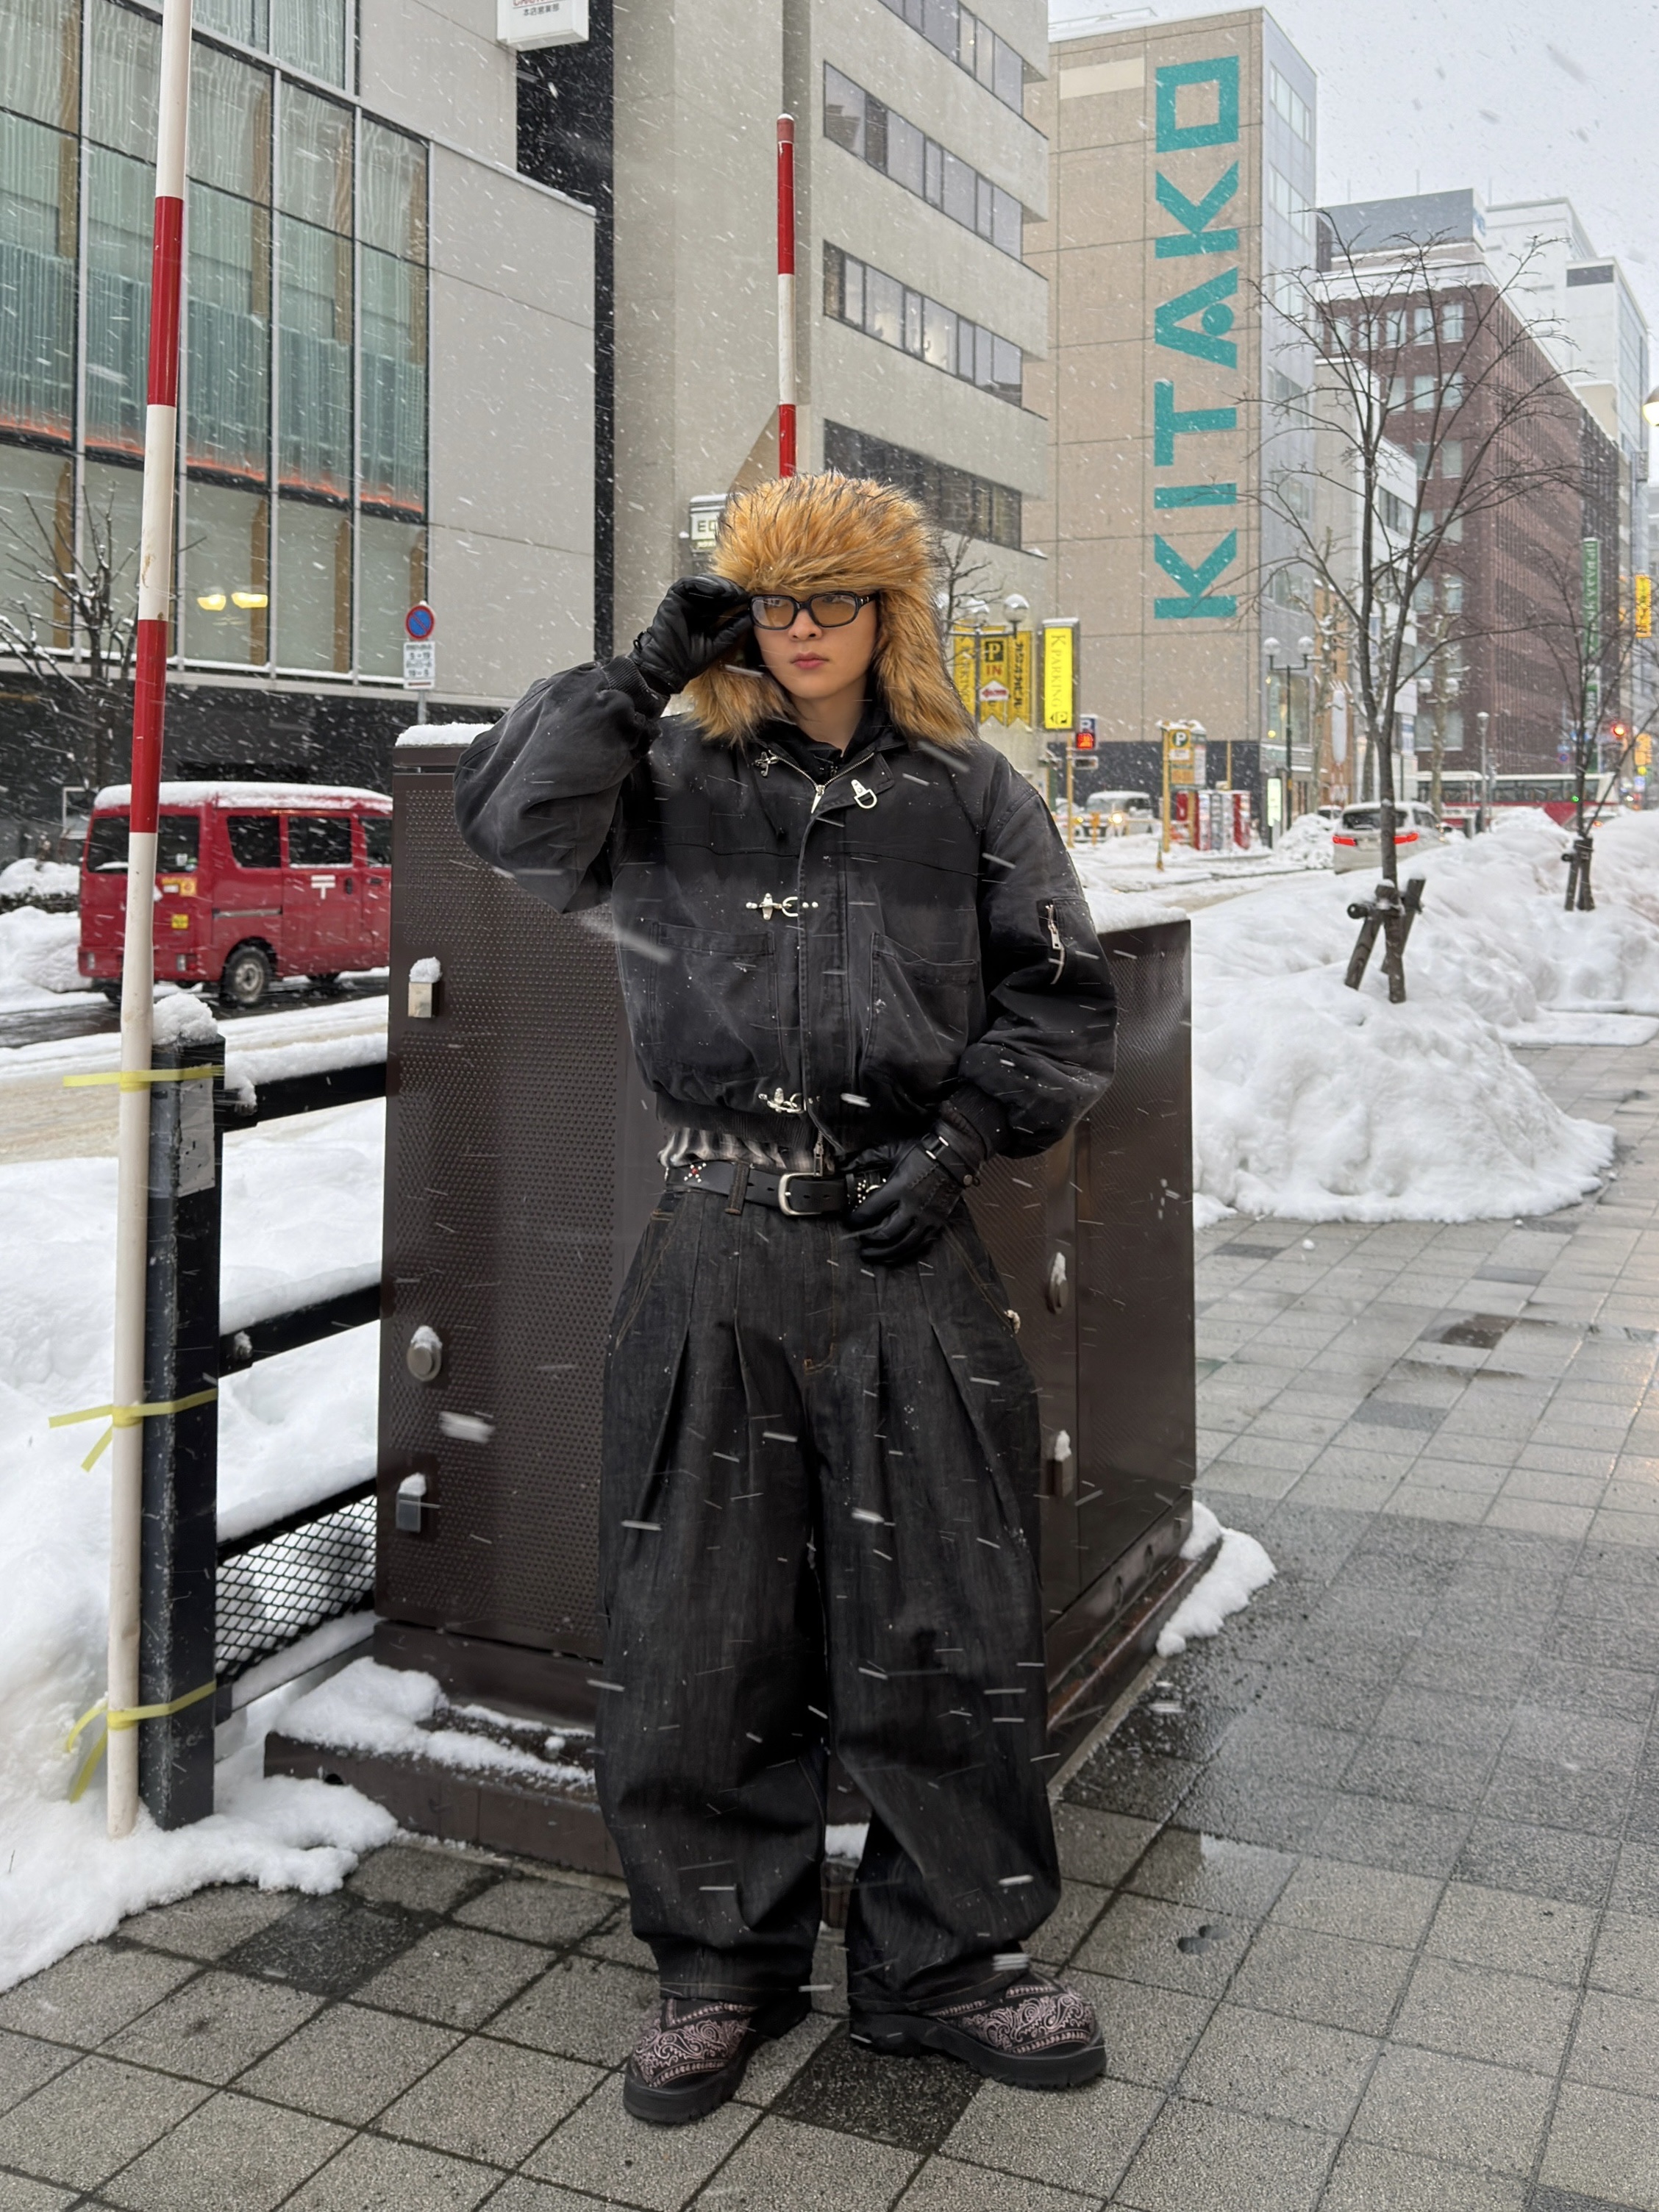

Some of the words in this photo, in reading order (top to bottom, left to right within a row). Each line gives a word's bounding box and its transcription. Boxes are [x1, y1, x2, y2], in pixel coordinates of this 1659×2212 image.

[1155, 55, 1238, 619] KITAKO
[1051, 635, 1066, 647] K
[988, 642, 1002, 661] P
[986, 665, 1003, 676] IN
[1051, 649, 1063, 707] PARKING
[1175, 732, 1186, 746] P
